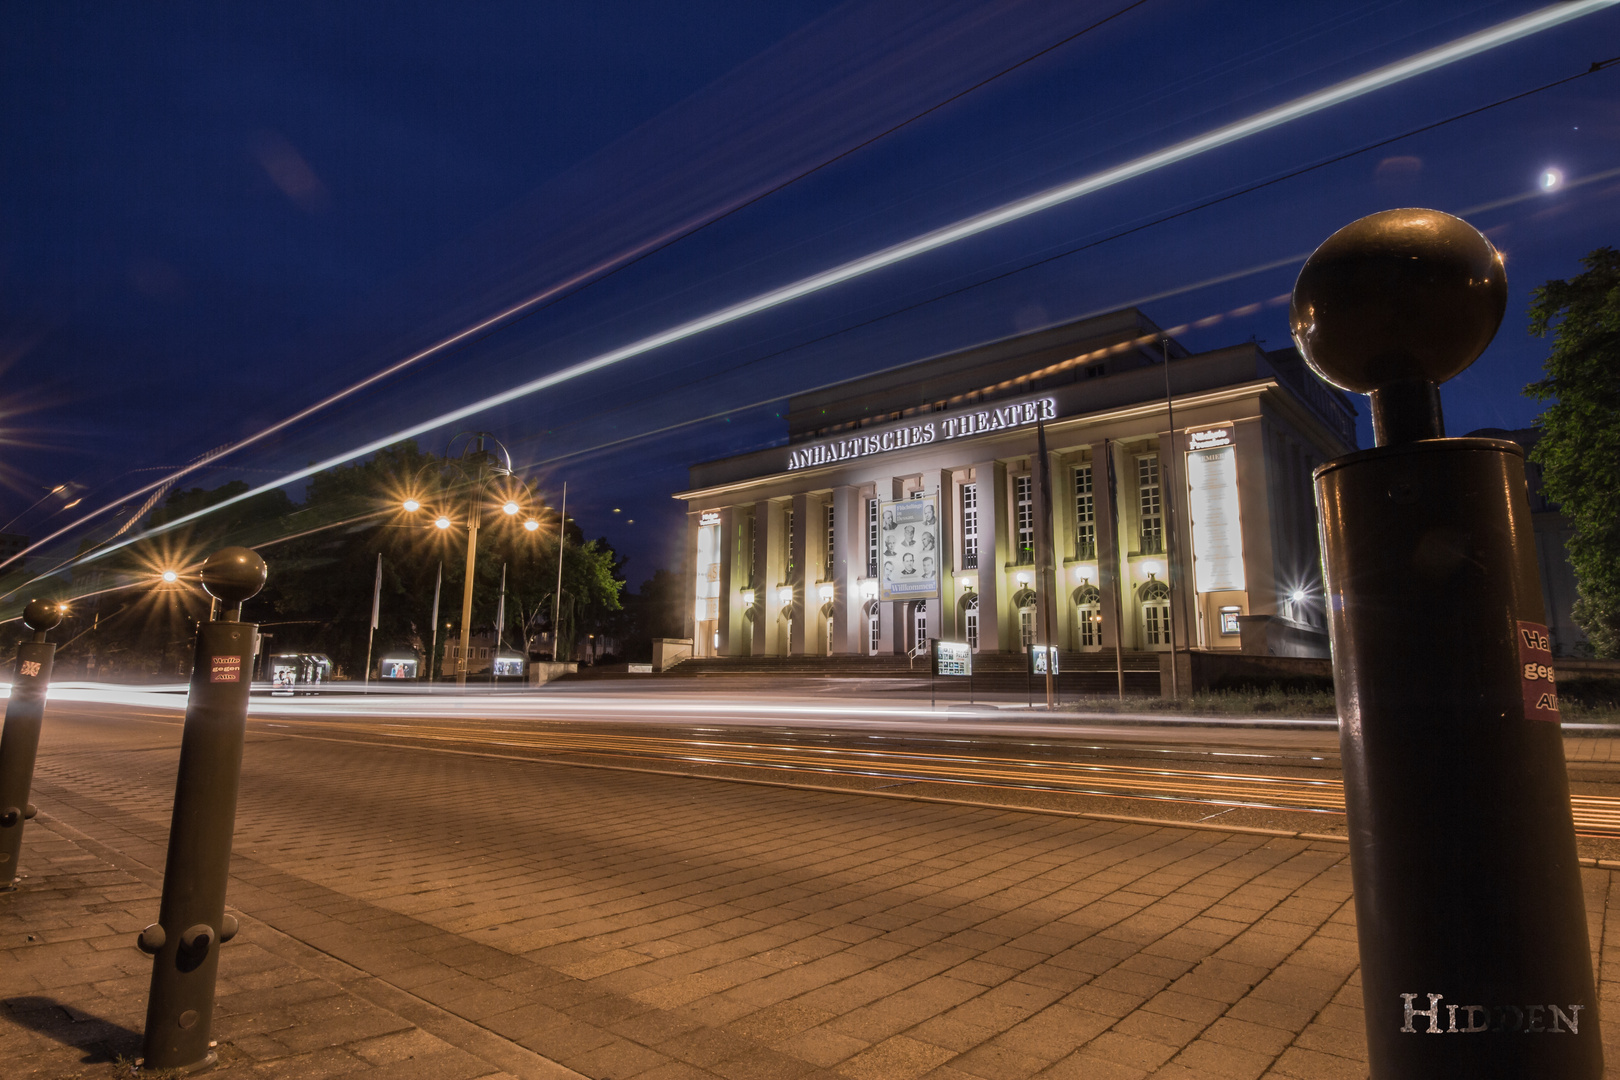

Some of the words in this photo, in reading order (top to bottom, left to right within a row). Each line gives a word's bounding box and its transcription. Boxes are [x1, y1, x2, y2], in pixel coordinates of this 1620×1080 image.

[788, 422, 935, 470] ANHALTISCHES
[942, 398, 1057, 440] THEATER
[891, 582, 936, 592] Willkommen!
